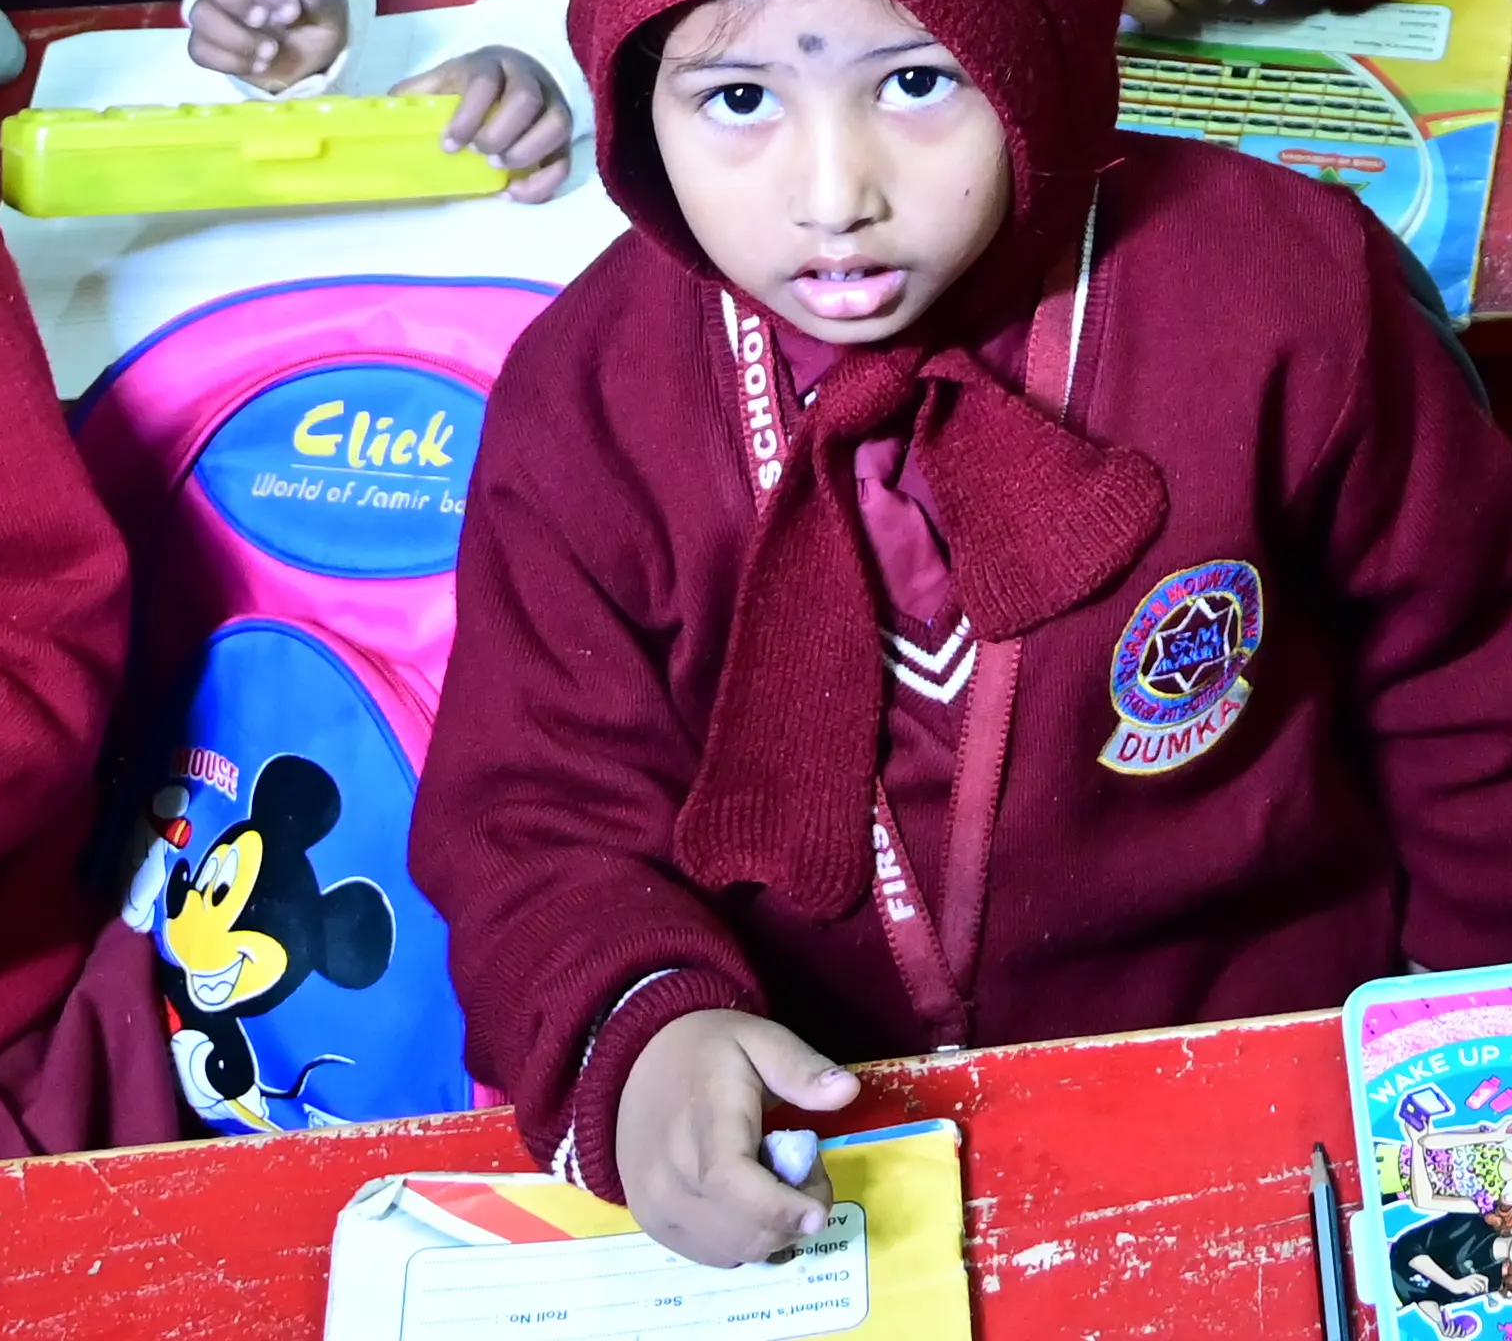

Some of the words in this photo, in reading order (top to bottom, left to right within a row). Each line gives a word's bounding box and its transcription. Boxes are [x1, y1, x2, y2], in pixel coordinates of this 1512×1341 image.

[294, 400, 454, 468] Click
[252, 473, 324, 500] World
[326, 481, 356, 503] of
[357, 485, 430, 510] Samir
[1117, 698, 1240, 763] DUMKA
[871, 805, 916, 922] FIRS
[1369, 1052, 1450, 1104] WAKE
[1457, 1046, 1500, 1066] UP
[790, 1240, 848, 1258] Subject
[807, 1269, 849, 1284] Class
[654, 1295, 682, 1306] Sec
[777, 1297, 850, 1316] Student's
[505, 1313, 531, 1324] No.
[536, 1310, 567, 1322] Roll
[726, 1309, 771, 1324] Name
